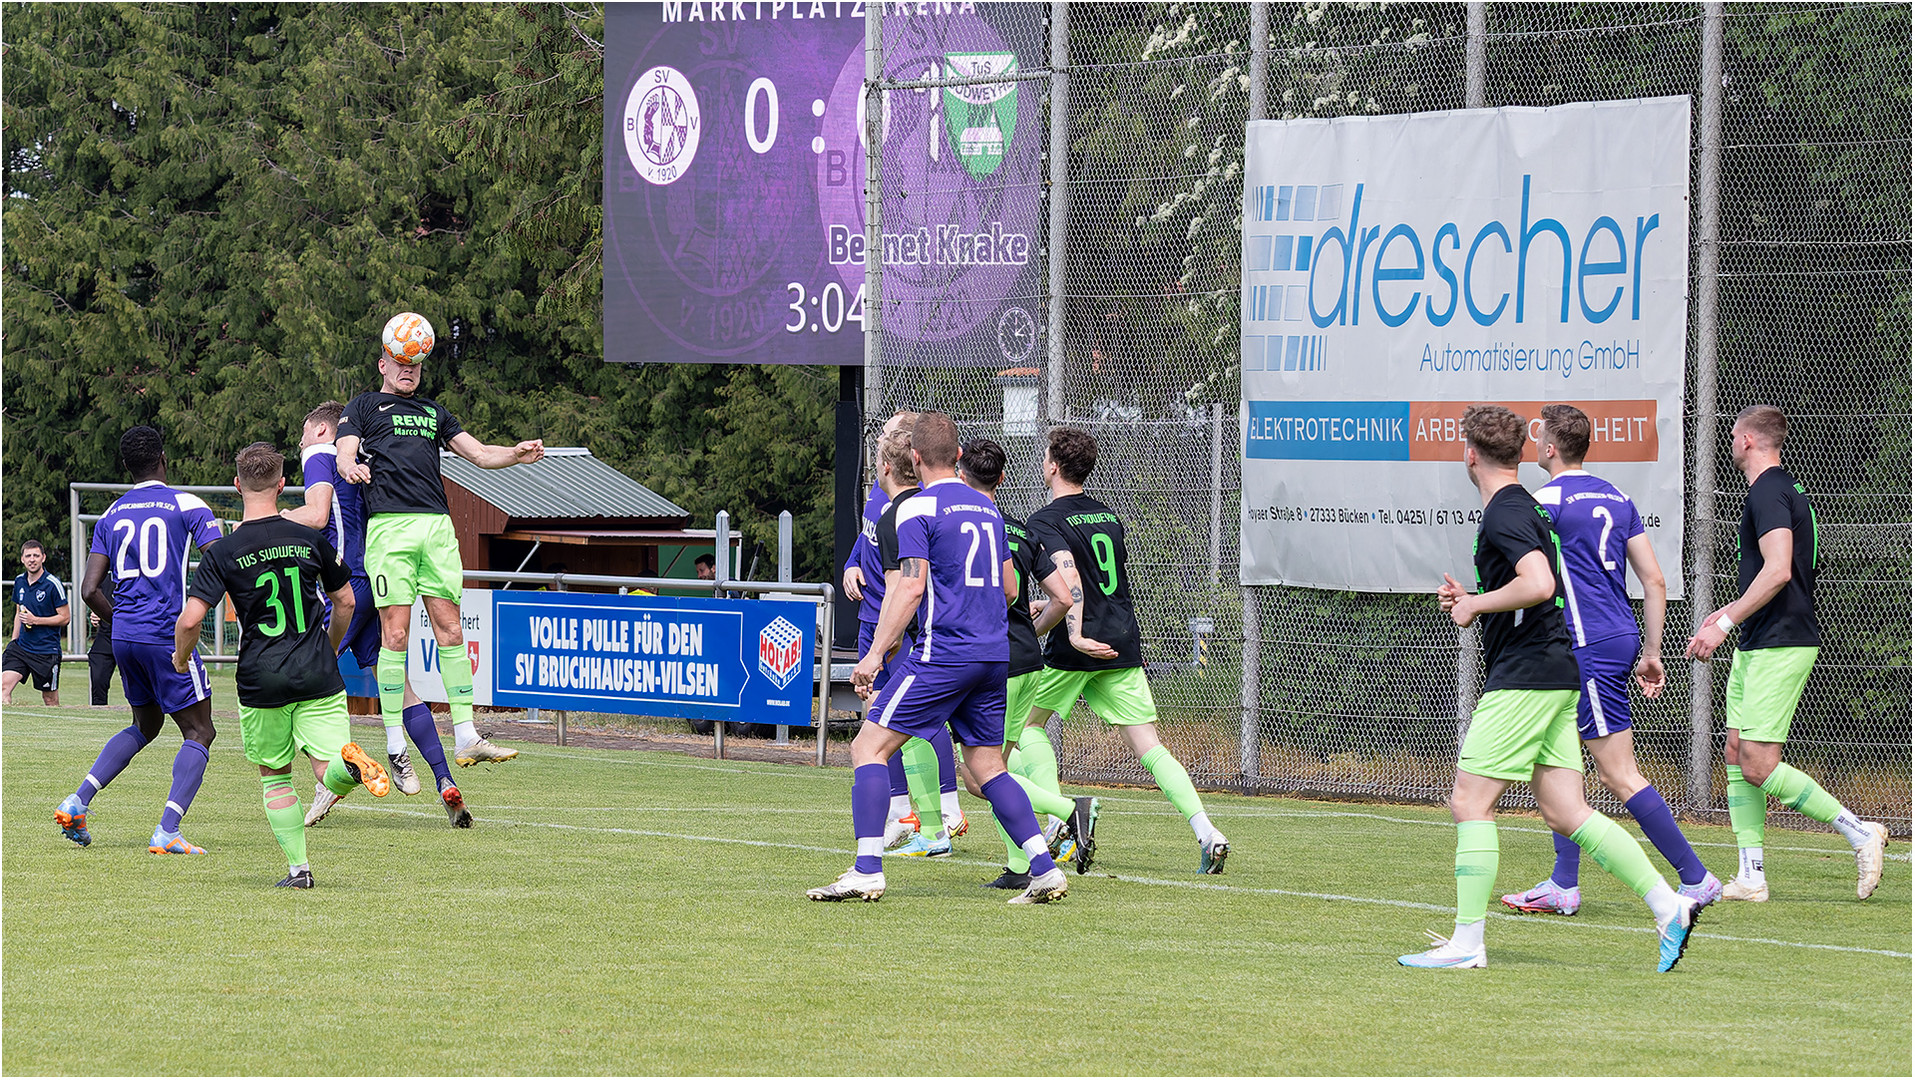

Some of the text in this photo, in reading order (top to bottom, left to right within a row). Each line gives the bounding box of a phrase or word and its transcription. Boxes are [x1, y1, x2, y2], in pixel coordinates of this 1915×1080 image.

[654, 69, 670, 84] SV
[971, 61, 992, 75] TuS
[626, 117, 635, 132] B
[689, 116, 699, 130] V
[745, 77, 779, 154] 0
[656, 165, 678, 182] 1920
[829, 222, 1029, 265] Benet Knake
[1308, 174, 1660, 329] drescher
[785, 282, 866, 333] 3:04
[1419, 339, 1640, 379] Automatisierung GmbH
[391, 414, 438, 432] REWE
[394, 427, 419, 437] Marco
[1250, 416, 1404, 442] ELEKTROTECHNIK
[1296, 506, 1303, 521] 8
[1310, 507, 1337, 523] 27333
[1338, 508, 1370, 524] Bücken
[1378, 509, 1395, 524] Tel.
[1396, 509, 1427, 525] 04251
[1436, 510, 1449, 525] 67
[1451, 510, 1465, 525] 13
[113, 517, 168, 579] 20
[960, 521, 1000, 588] 21
[1592, 505, 1617, 571] 2
[236, 553, 258, 570] TUS
[1090, 533, 1118, 596] 9
[255, 566, 306, 637] 31
[529, 613, 703, 657] VOLLE PULLE FÜR DEN
[515, 653, 719, 697] SV BRUCHHAUSEN-VILSEN
